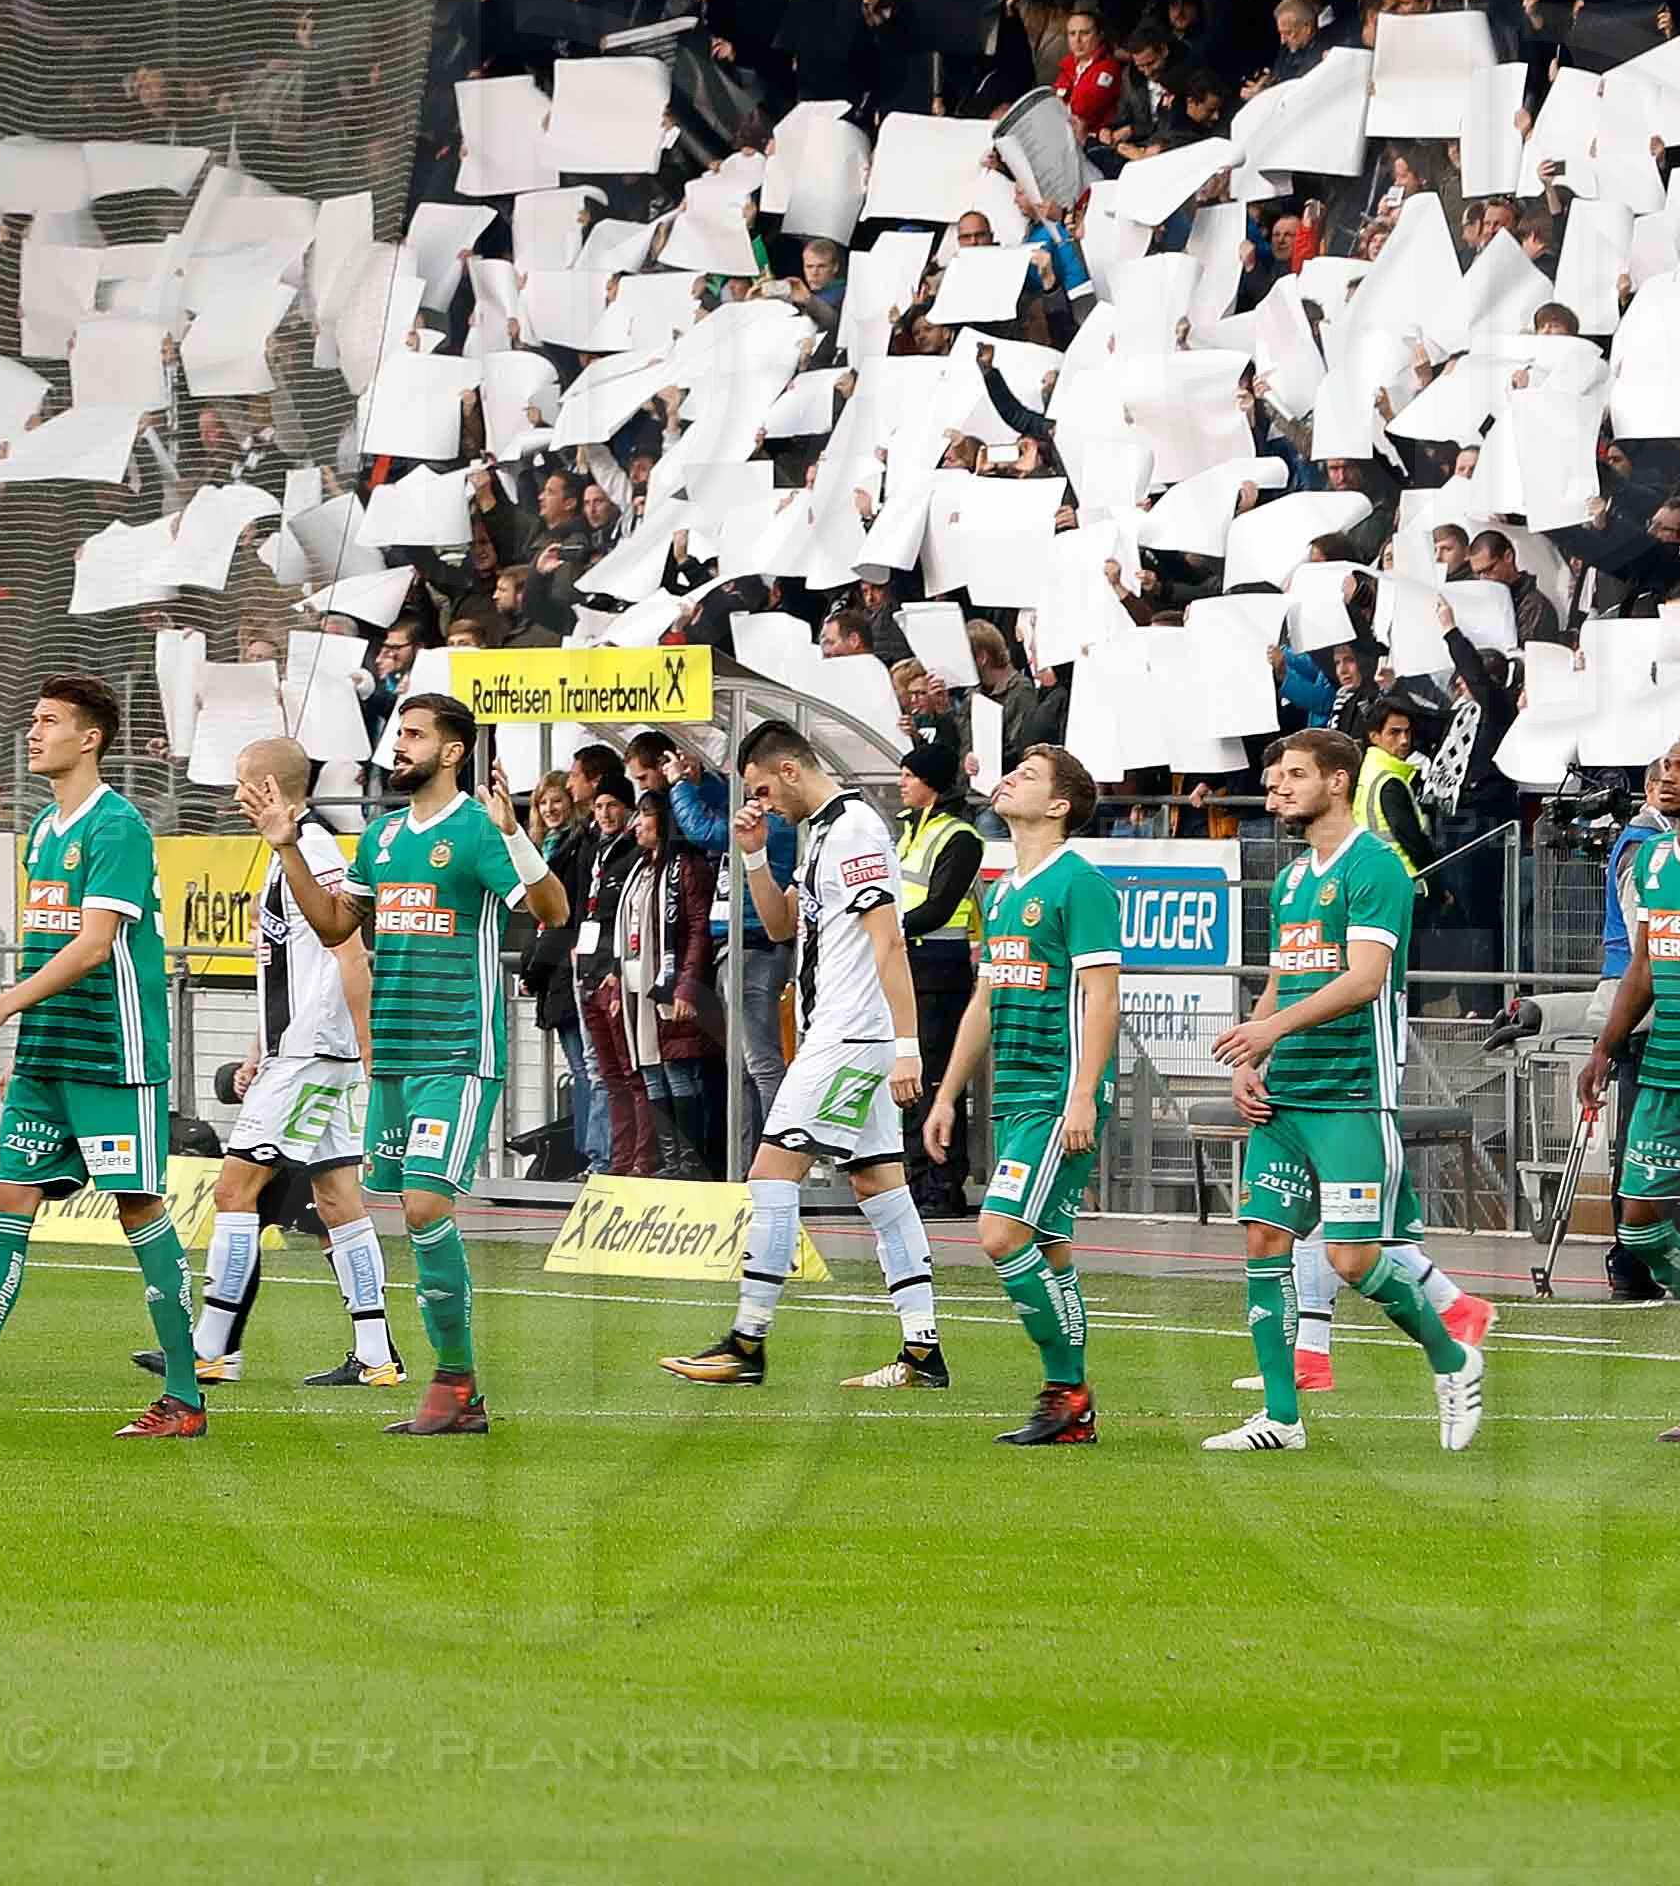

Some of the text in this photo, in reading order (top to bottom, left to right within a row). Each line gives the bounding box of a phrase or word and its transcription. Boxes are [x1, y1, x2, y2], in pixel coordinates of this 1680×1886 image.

[472, 671, 660, 714] Raiffeisen Trainerbank
[380, 887, 433, 907] WIEN
[1118, 875, 1218, 951] ÜGGER
[377, 910, 451, 933] NERGIE
[590, 1202, 719, 1261] Raiffeisen
